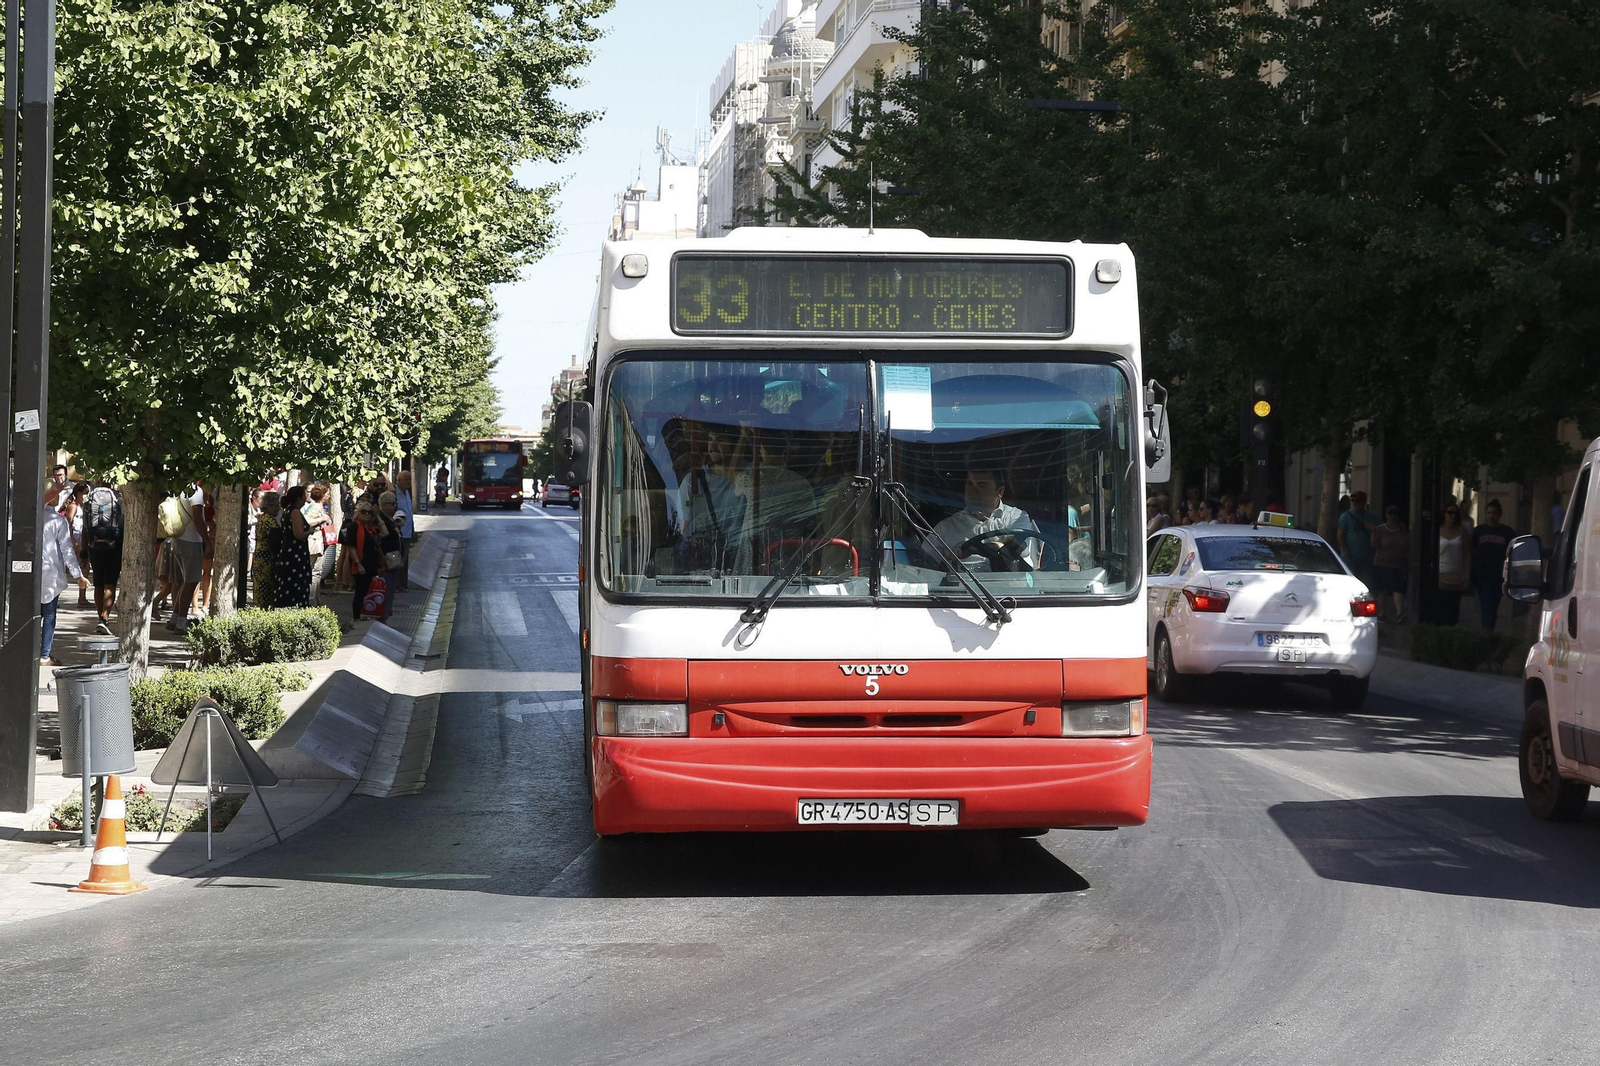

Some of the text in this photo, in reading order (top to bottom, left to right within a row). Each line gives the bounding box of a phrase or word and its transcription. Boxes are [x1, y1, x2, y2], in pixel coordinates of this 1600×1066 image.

[823, 273, 855, 298] DE
[868, 273, 1023, 298] AUTOBUSES
[680, 274, 749, 323] 33
[796, 303, 900, 329] CENTRO
[1266, 634, 1321, 646] 9627 JJS
[838, 664, 909, 676] VOLVO
[865, 675, 880, 696] 5
